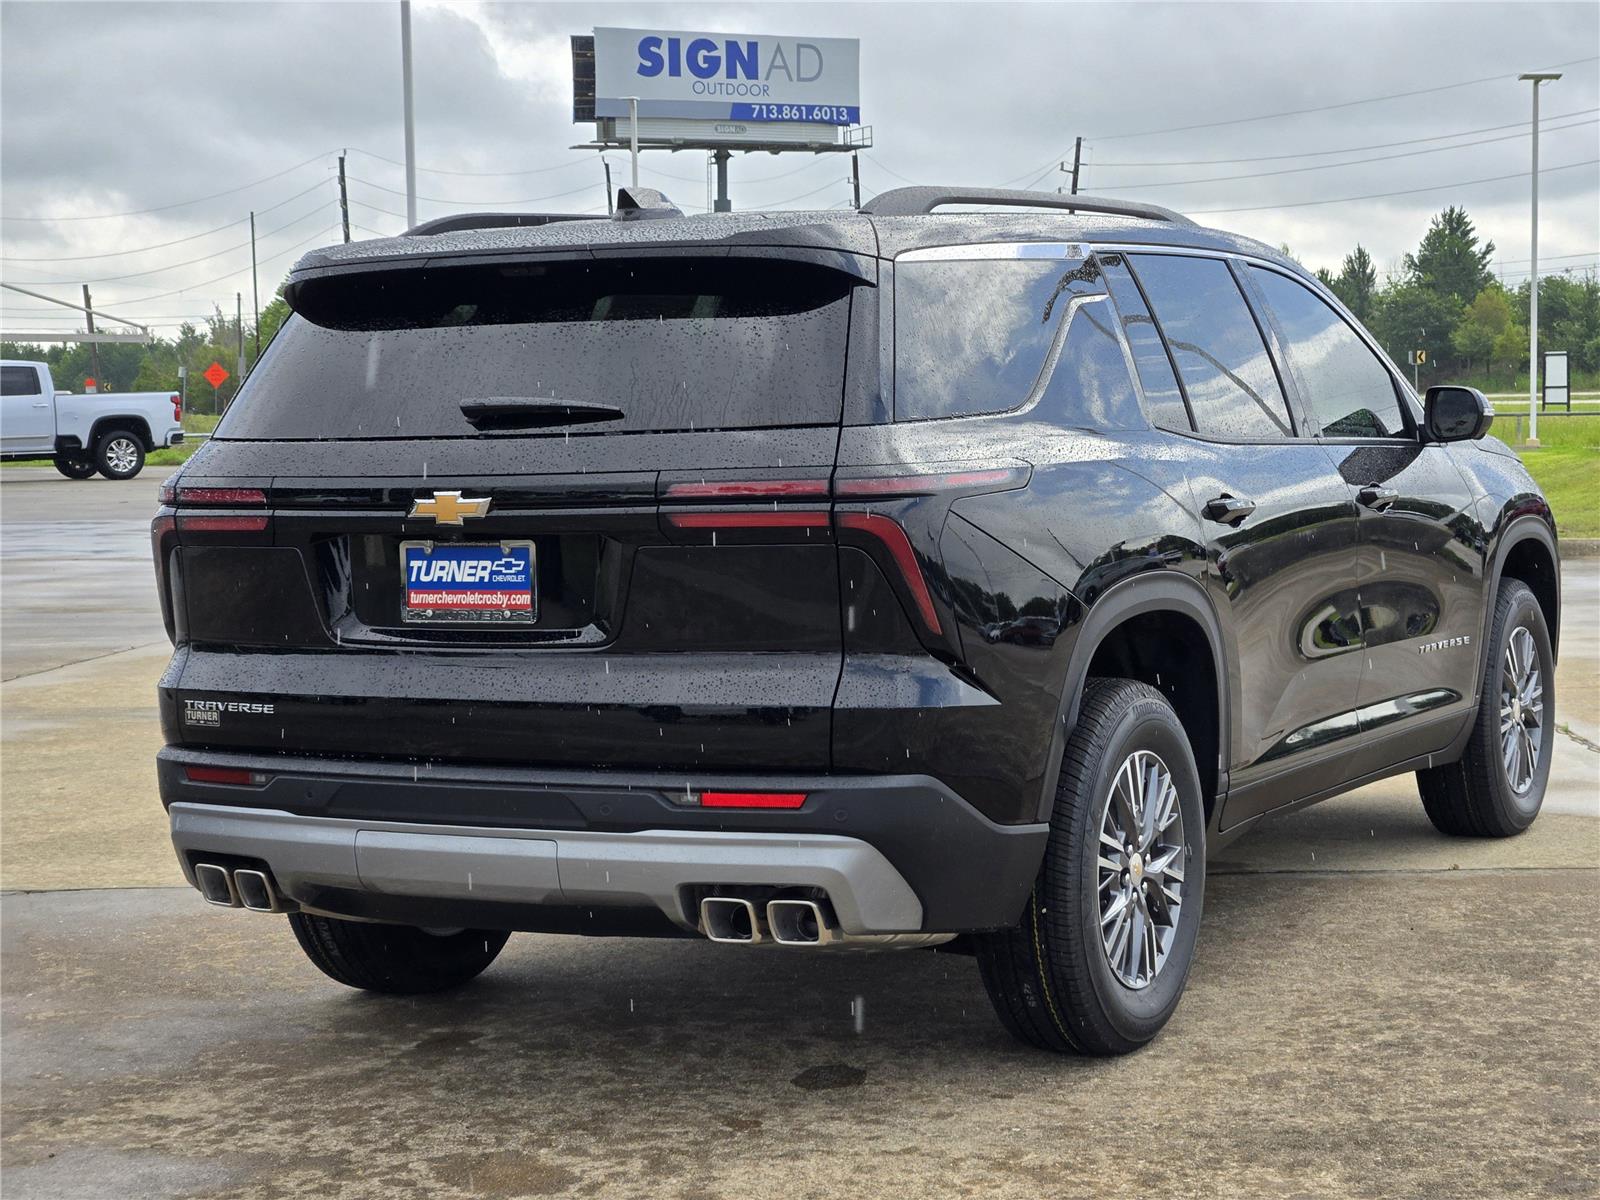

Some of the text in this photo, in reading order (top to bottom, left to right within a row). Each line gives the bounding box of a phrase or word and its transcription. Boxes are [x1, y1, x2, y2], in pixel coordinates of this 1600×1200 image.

[692, 80, 770, 97] OUTDOOR
[751, 104, 848, 121] 713.861.6013
[409, 560, 493, 582] TURNER
[410, 592, 531, 607] turnerchevroletcrosby.com
[1418, 636, 1470, 655] TRAVERSE
[184, 700, 275, 714] TRAVERSE
[186, 710, 218, 721] TURNER
